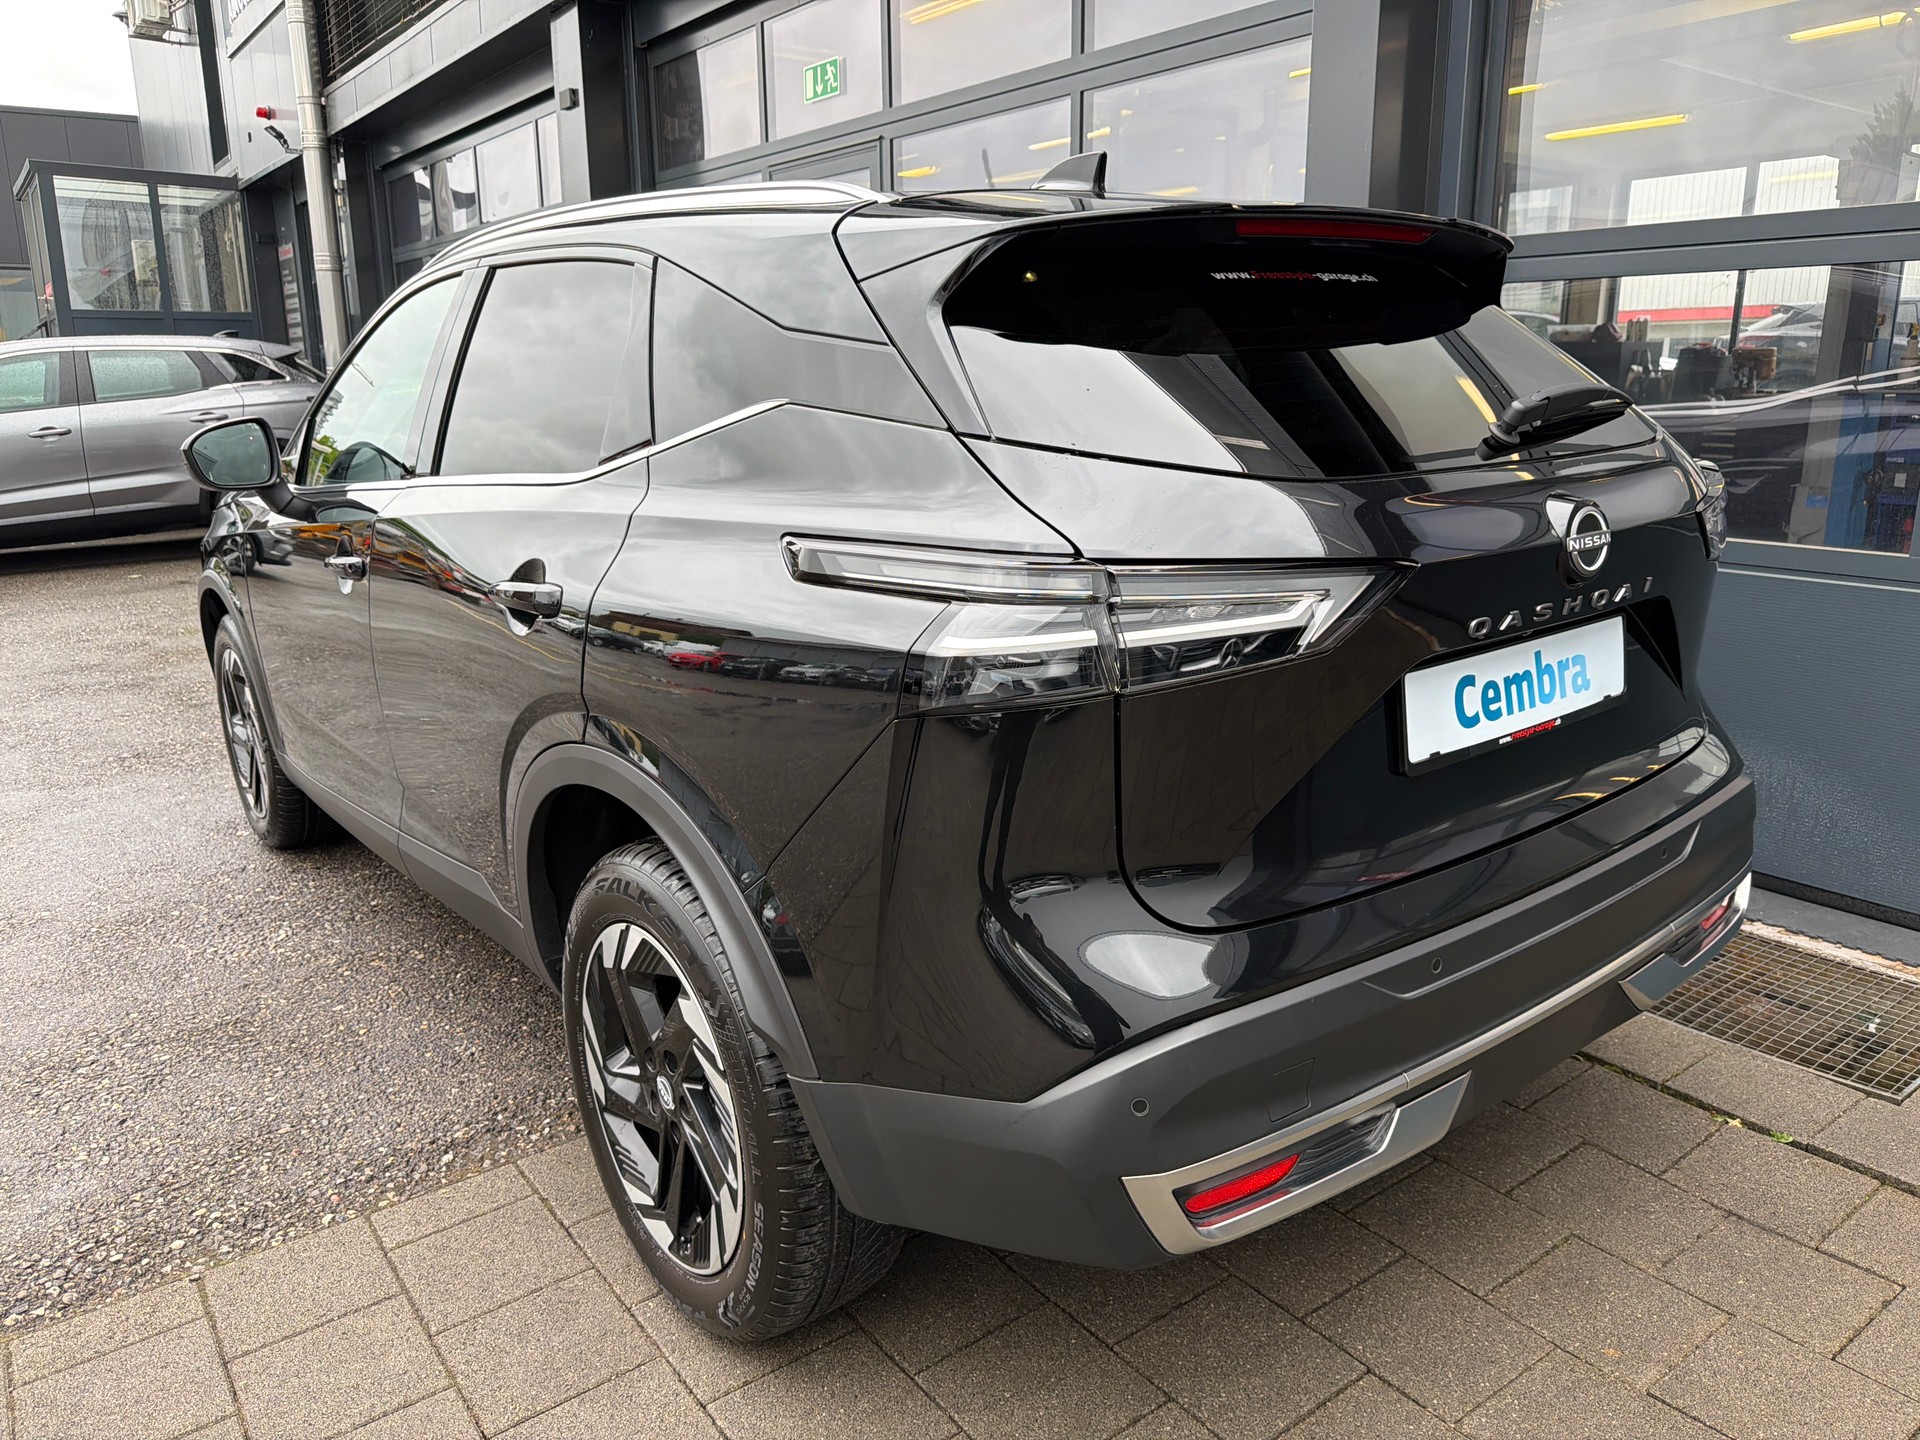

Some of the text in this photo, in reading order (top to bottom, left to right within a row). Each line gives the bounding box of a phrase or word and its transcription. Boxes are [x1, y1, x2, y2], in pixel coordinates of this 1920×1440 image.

[1569, 533, 1611, 550] NISSAN
[1468, 577, 1653, 639] QASHQAI
[1454, 650, 1591, 729] Cembra
[745, 1200, 765, 1292] SEASON
